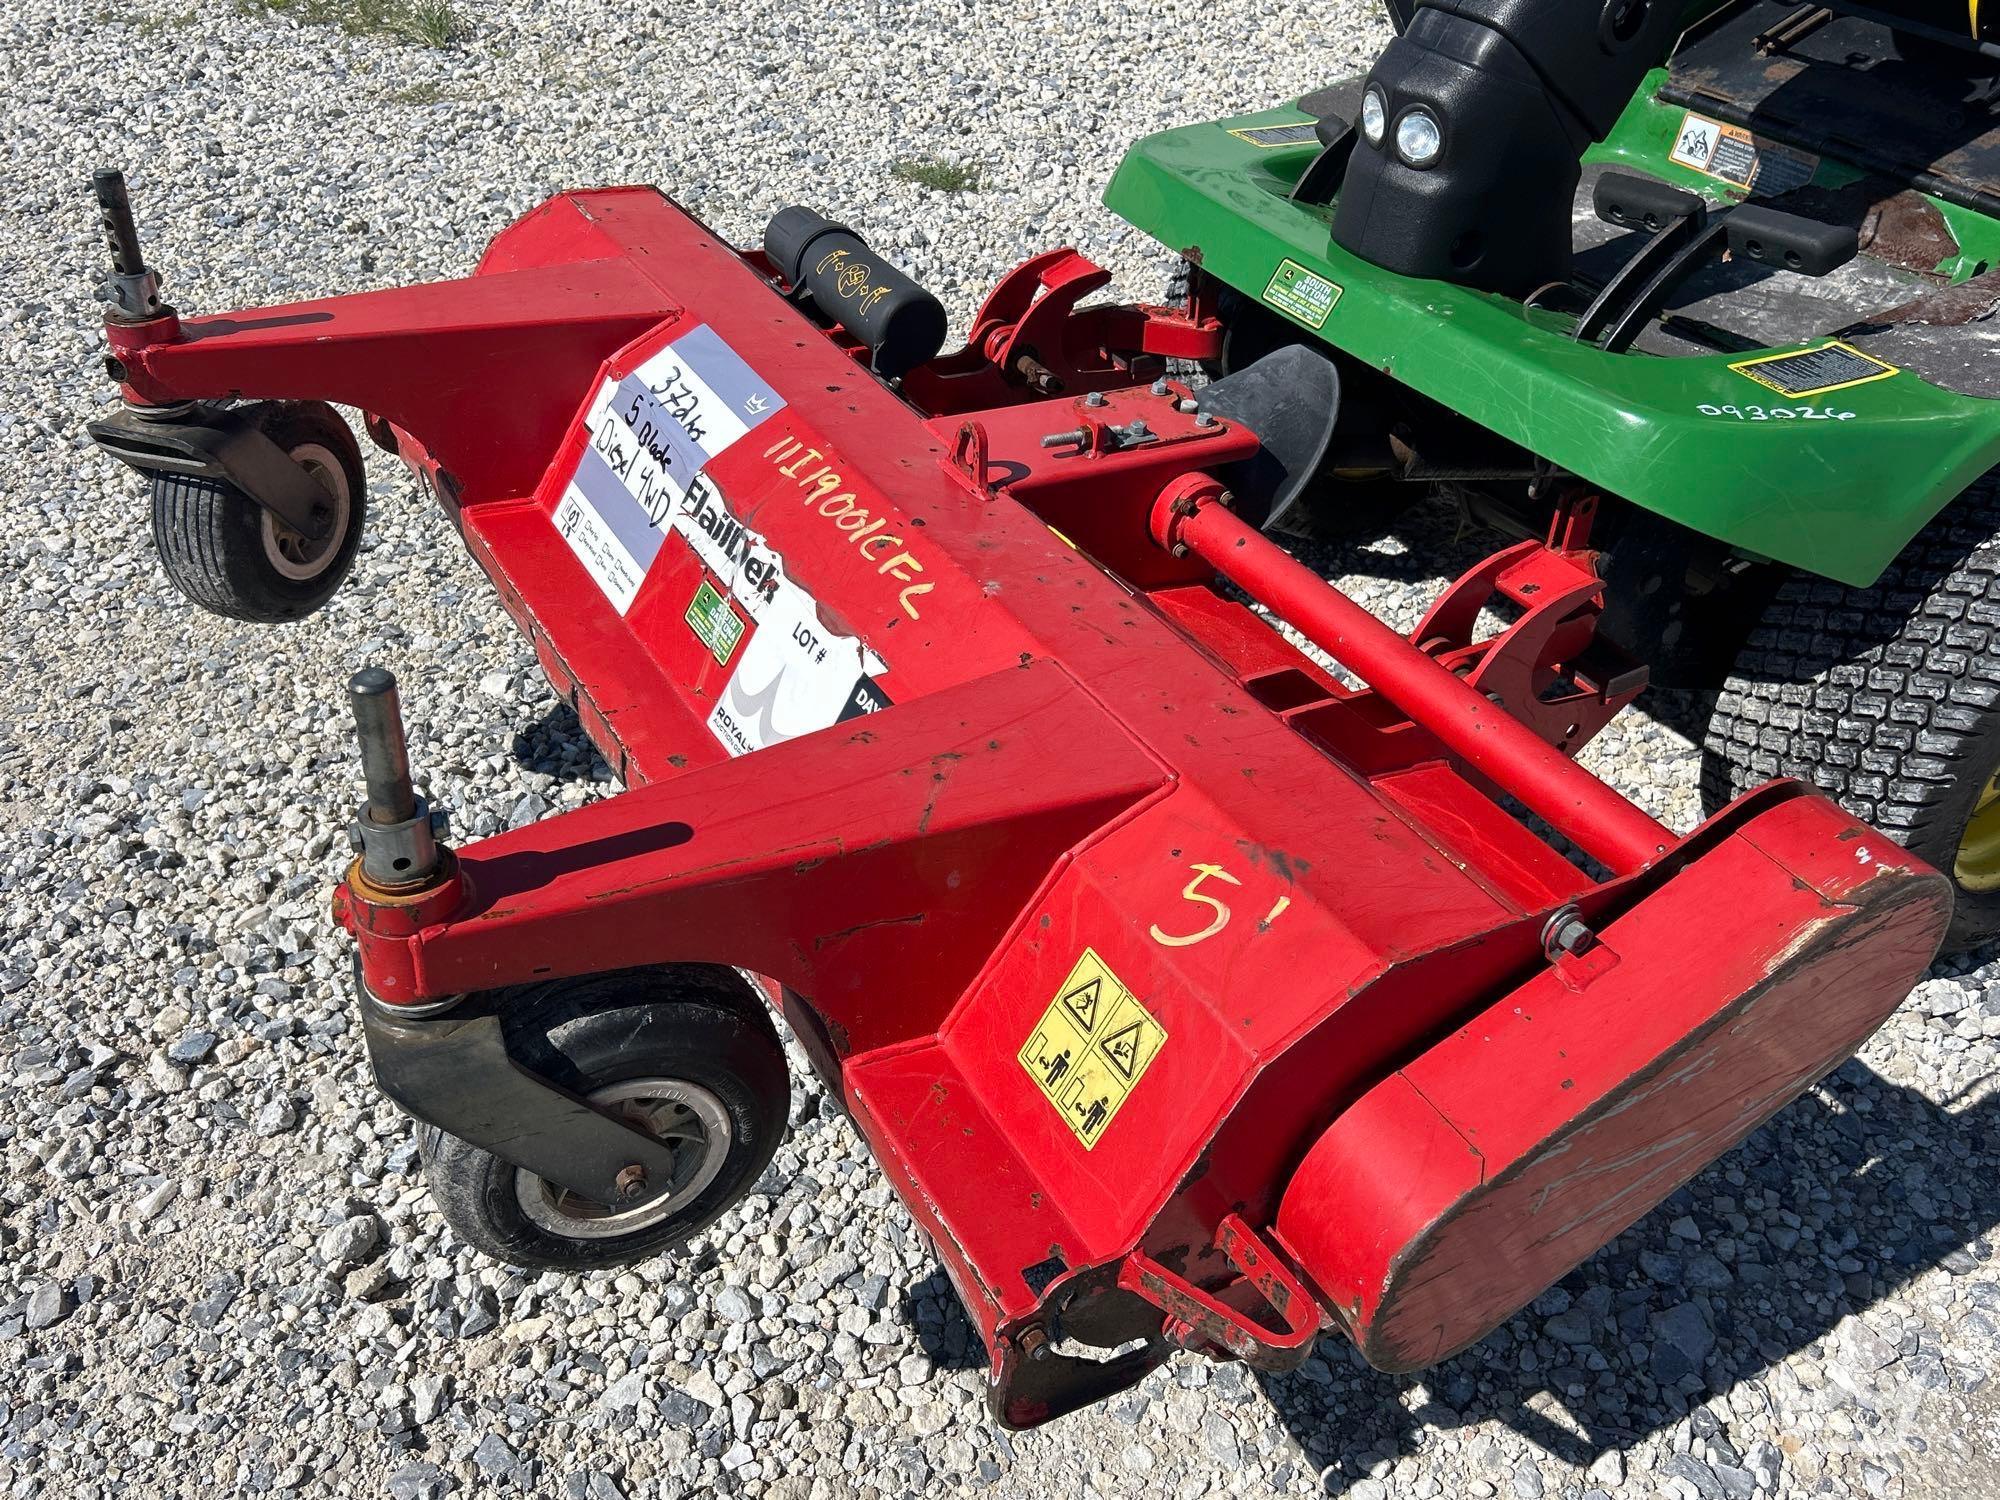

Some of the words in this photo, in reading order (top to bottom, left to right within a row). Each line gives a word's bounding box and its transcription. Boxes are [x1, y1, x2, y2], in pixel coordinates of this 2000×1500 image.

[1294, 281, 1331, 305] DAYTONA
[1304, 276, 1332, 295] SOUTH
[1696, 404, 1856, 420] 093026
[638, 422, 672, 473] Blade
[792, 621, 819, 654] LOT
[815, 648, 828, 664] #
[713, 718, 736, 745] AUCTION
[717, 706, 746, 750] ROYAL
